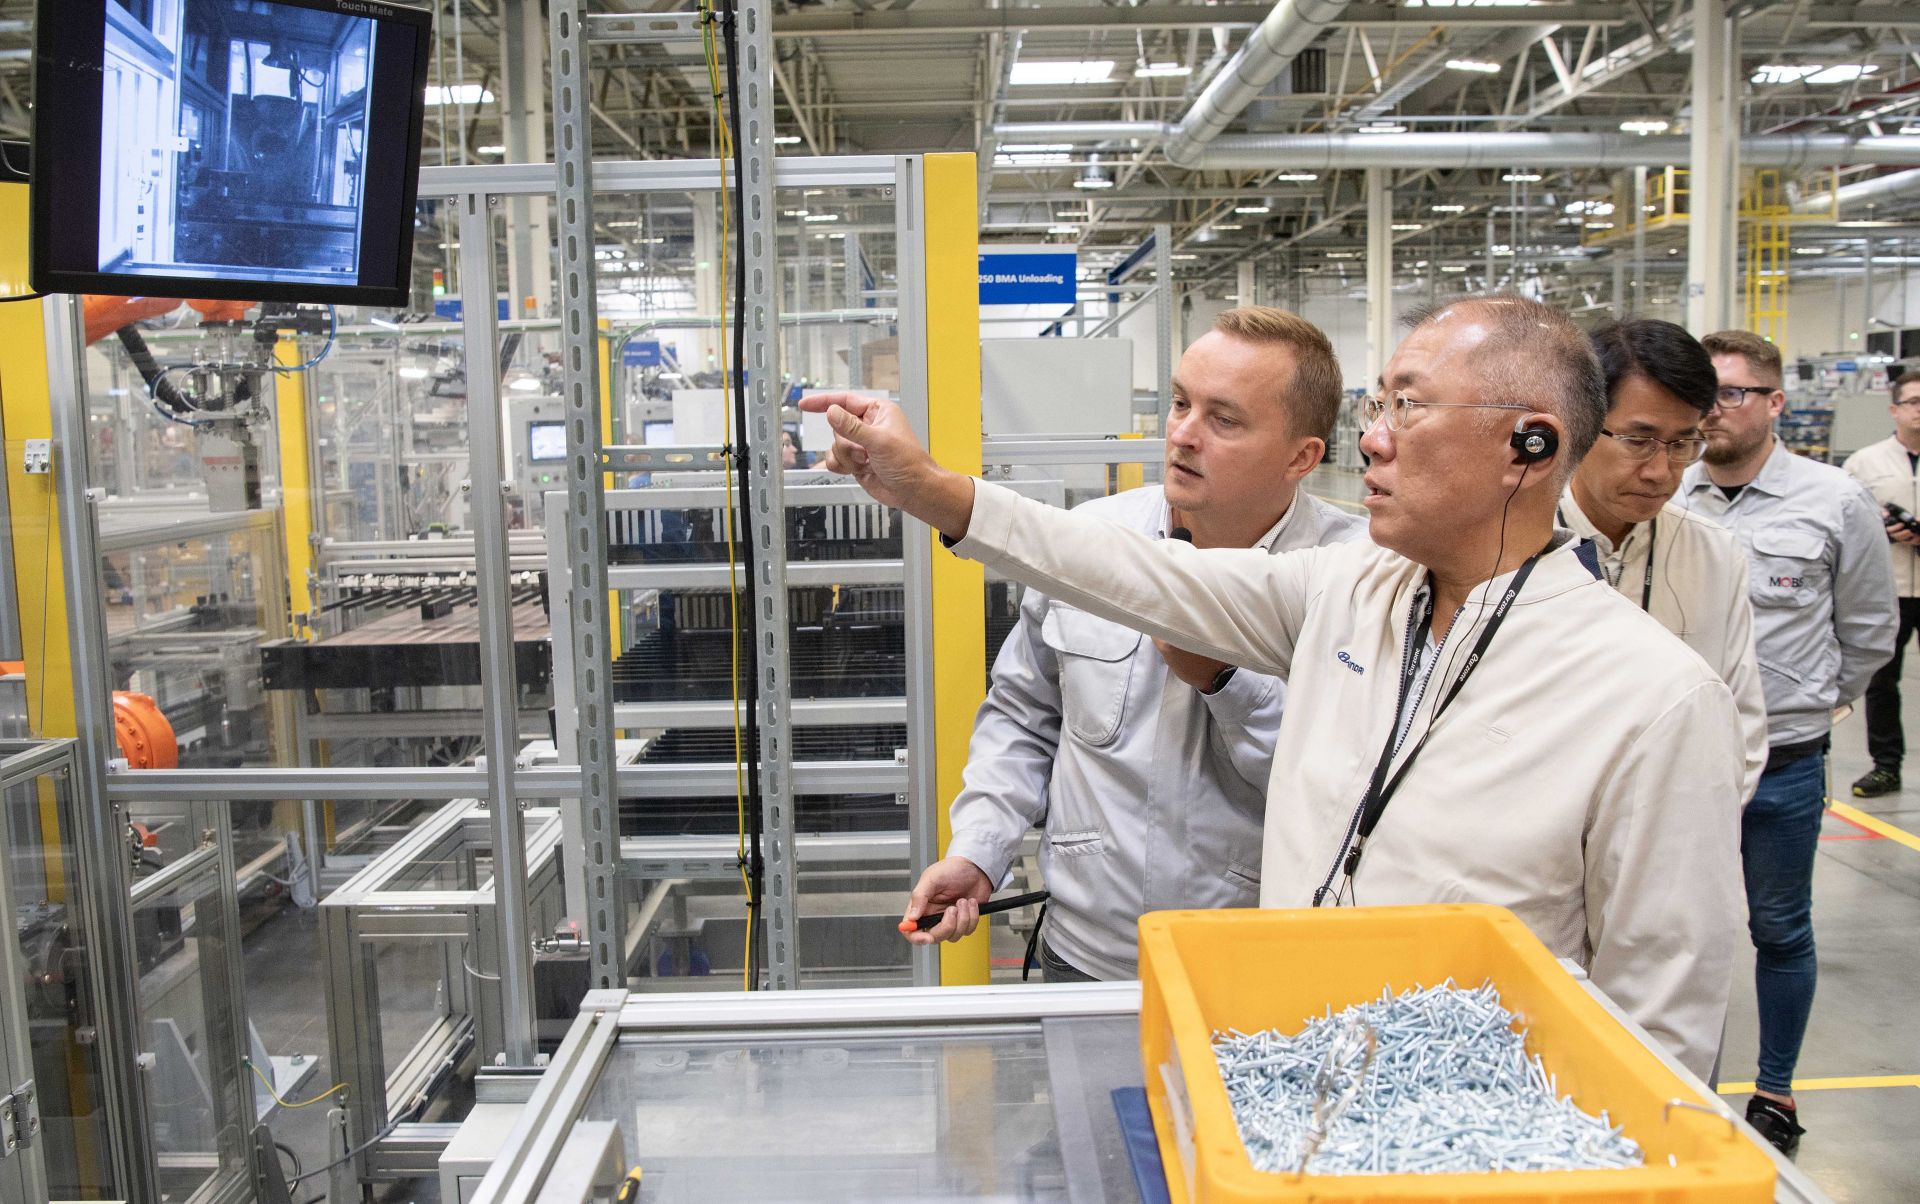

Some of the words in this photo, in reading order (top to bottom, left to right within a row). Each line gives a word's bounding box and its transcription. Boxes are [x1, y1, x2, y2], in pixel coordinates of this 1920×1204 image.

[336, 0, 367, 12] Touch
[369, 4, 393, 16] Mate
[995, 274, 1017, 284] BMA
[1018, 273, 1064, 285] Unloading
[1769, 576, 1804, 588] MOBS
[1495, 589, 1516, 618] earzone
[1407, 647, 1421, 676] earzone
[1459, 653, 1479, 682] earzone
